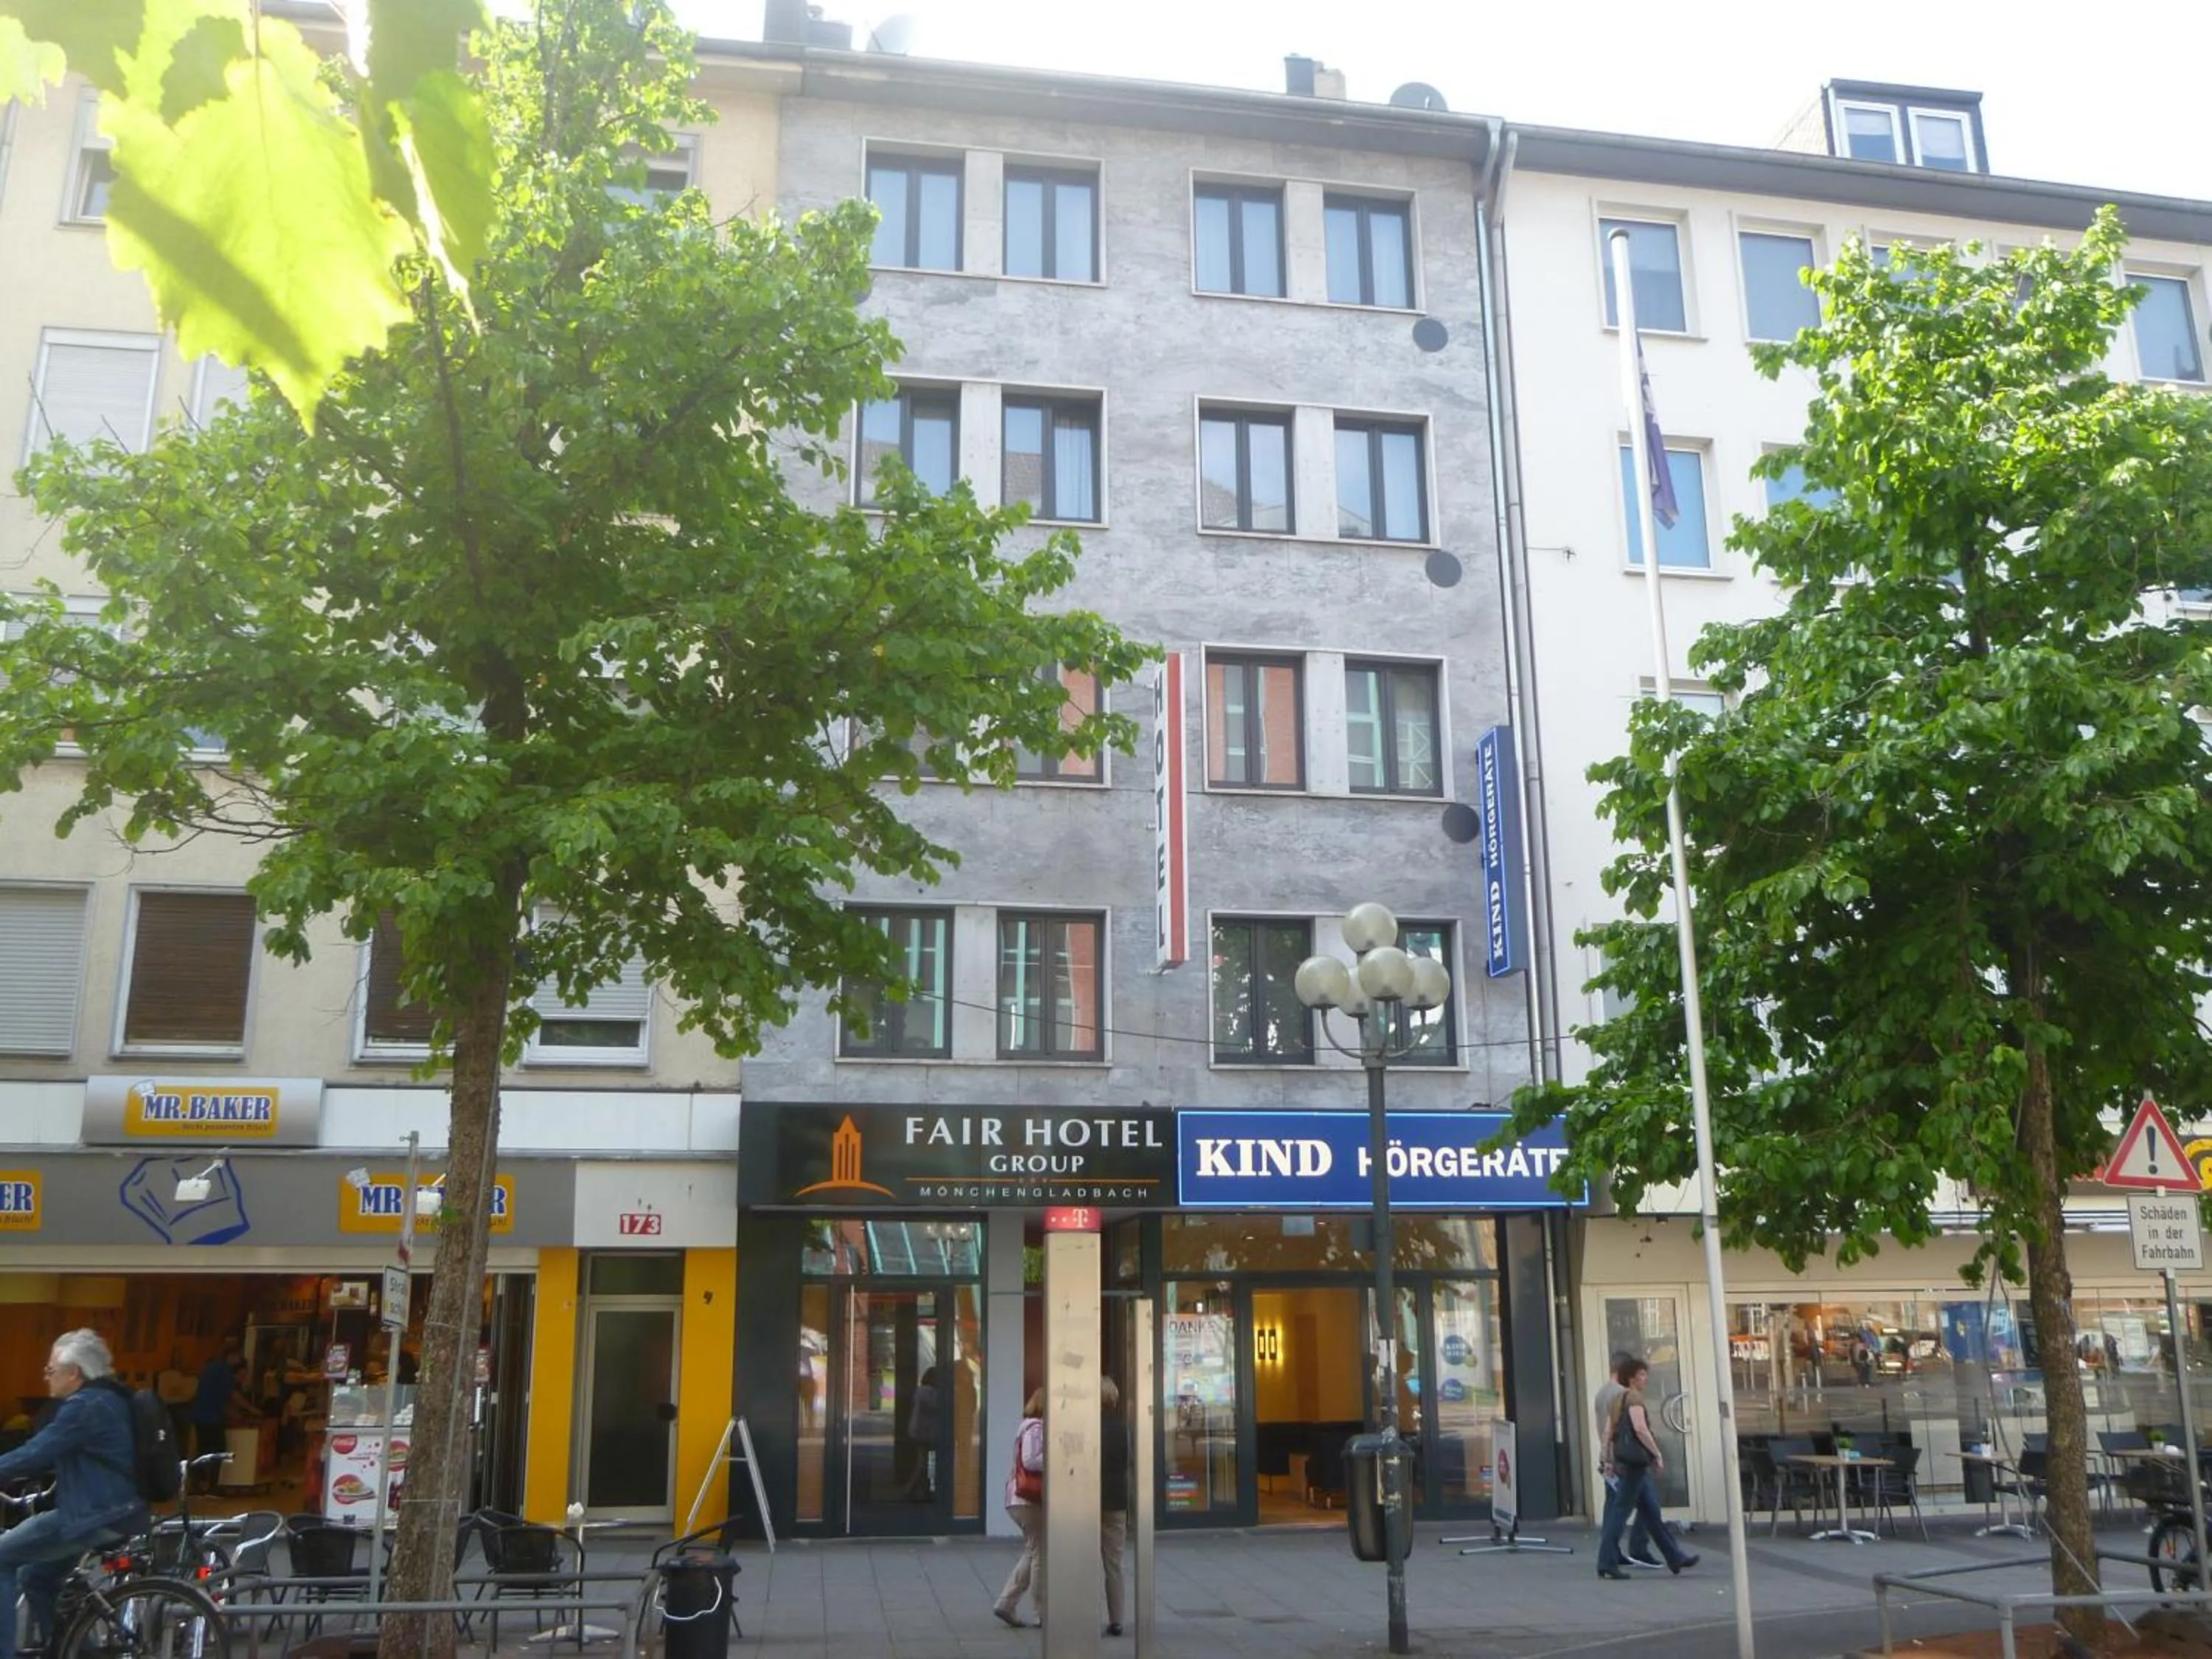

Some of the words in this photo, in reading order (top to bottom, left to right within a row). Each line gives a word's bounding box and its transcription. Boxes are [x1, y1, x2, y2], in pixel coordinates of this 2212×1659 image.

[1154, 669, 1165, 949] HOTEL
[1490, 880, 1504, 959] KIND
[143, 1095, 271, 1120] MR.BAKER
[905, 1117, 1004, 1145] FAIR
[1025, 1119, 1163, 1147] HOTEL
[990, 1155, 1085, 1173] GROUP
[1196, 1139, 1333, 1177] KIND
[919, 1186, 1147, 1198] MÖNCHENGLADBACH
[2140, 1206, 2187, 1220] Schäden
[622, 1215, 660, 1233] 173
[2148, 1225, 2159, 1239] in
[2166, 1226, 2183, 1239] der
[2142, 1245, 2194, 1259] Fahrbahn
